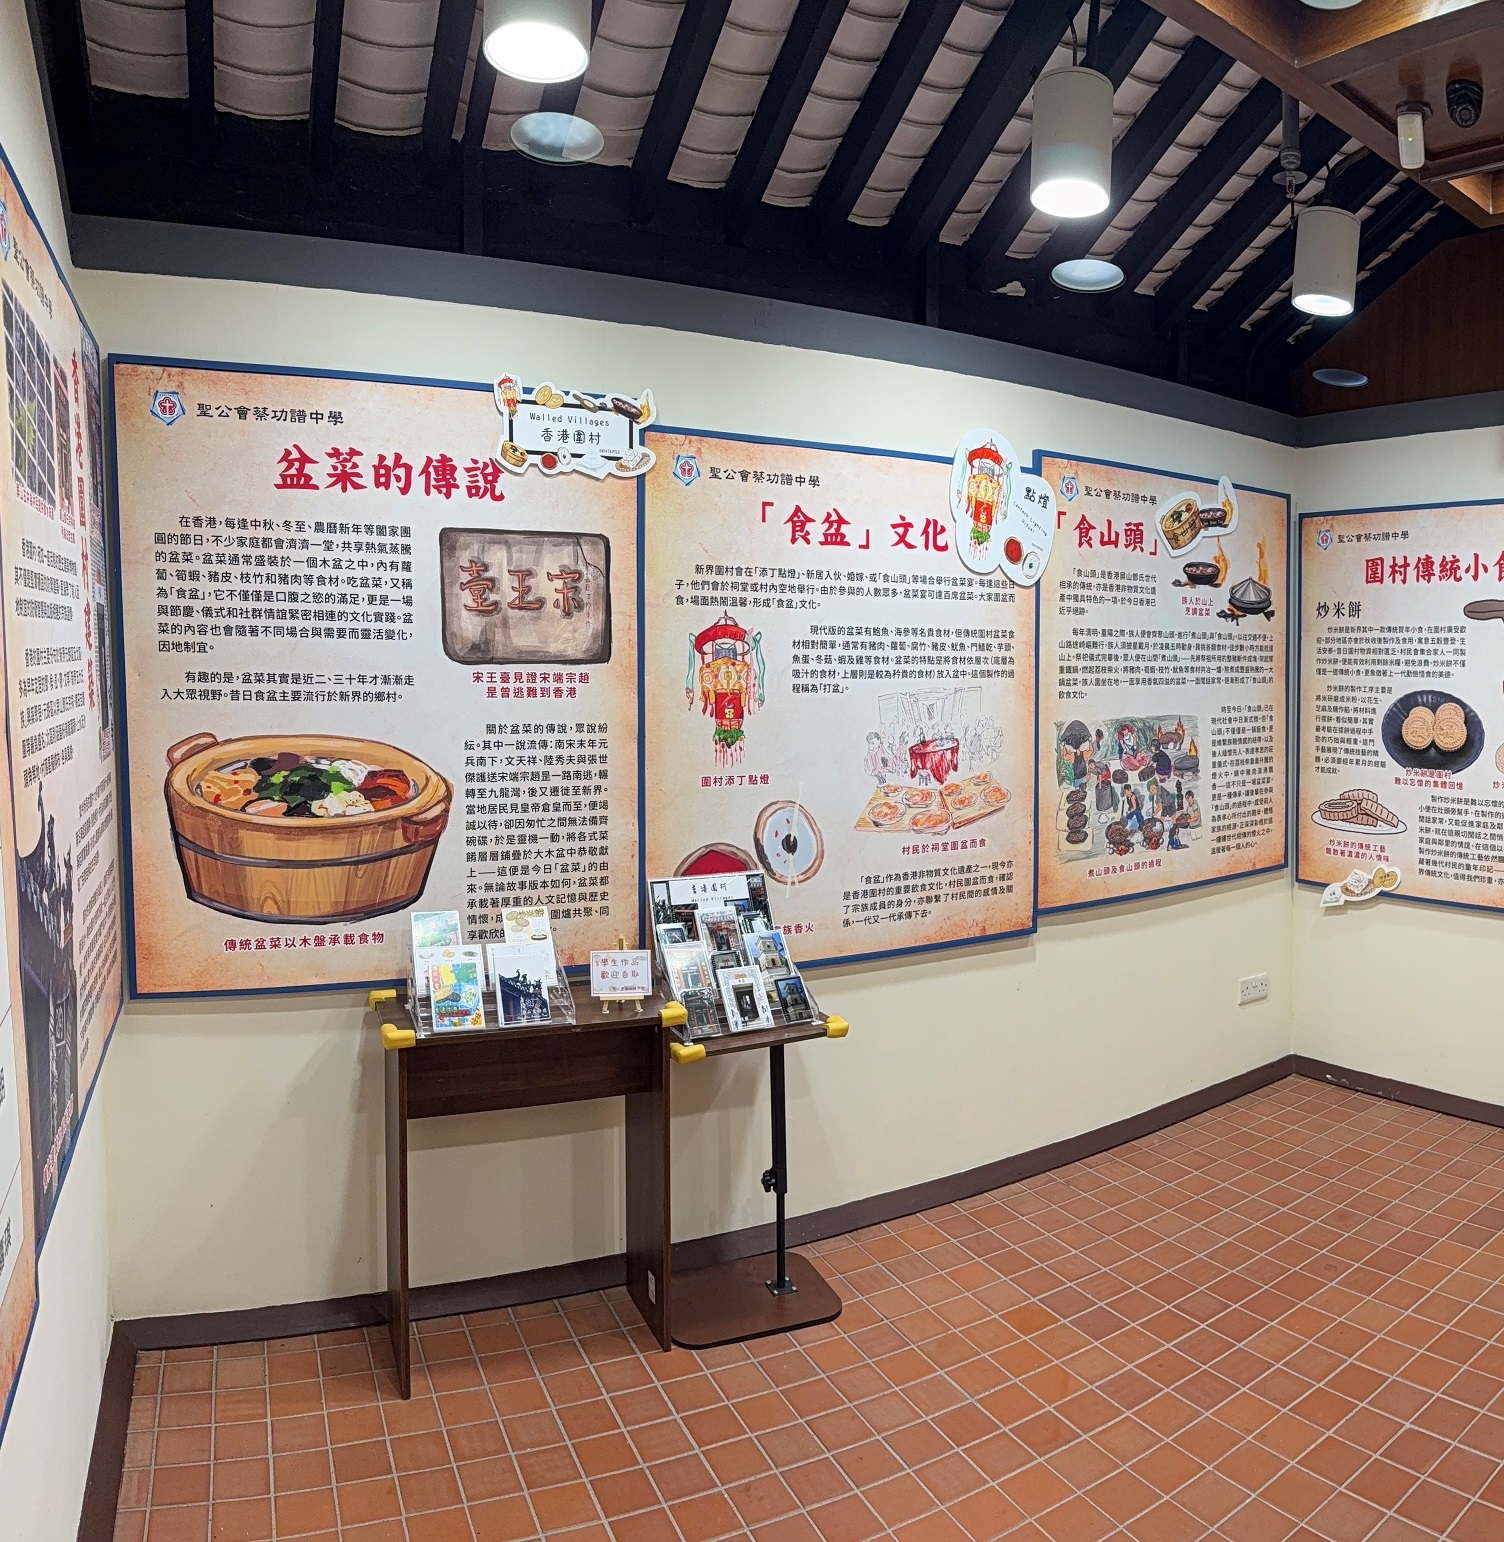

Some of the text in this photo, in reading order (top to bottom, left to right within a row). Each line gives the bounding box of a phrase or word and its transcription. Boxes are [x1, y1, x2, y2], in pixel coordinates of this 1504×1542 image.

[196, 402, 344, 426] 聖公會蔡功譜中學
[529, 412, 611, 426] Walled Villages
[541, 427, 602, 445] 香港圍村
[273, 444, 509, 502] 盆菜的傳說
[709, 466, 821, 489] 聖公會蔡功譜中學
[1023, 486, 1050, 510] 點燈
[761, 501, 950, 553] 「食盆」文化
[1057, 511, 1158, 556] 「食山頭」
[1315, 601, 1362, 620] 炒米餅
[158, 640, 215, 654] 因地制宜。
[701, 774, 770, 788] 圍村添丁點燈
[224, 931, 385, 951] 傳統盆菜以木盤承載食物
[600, 969, 640, 980] 歡迎自取
